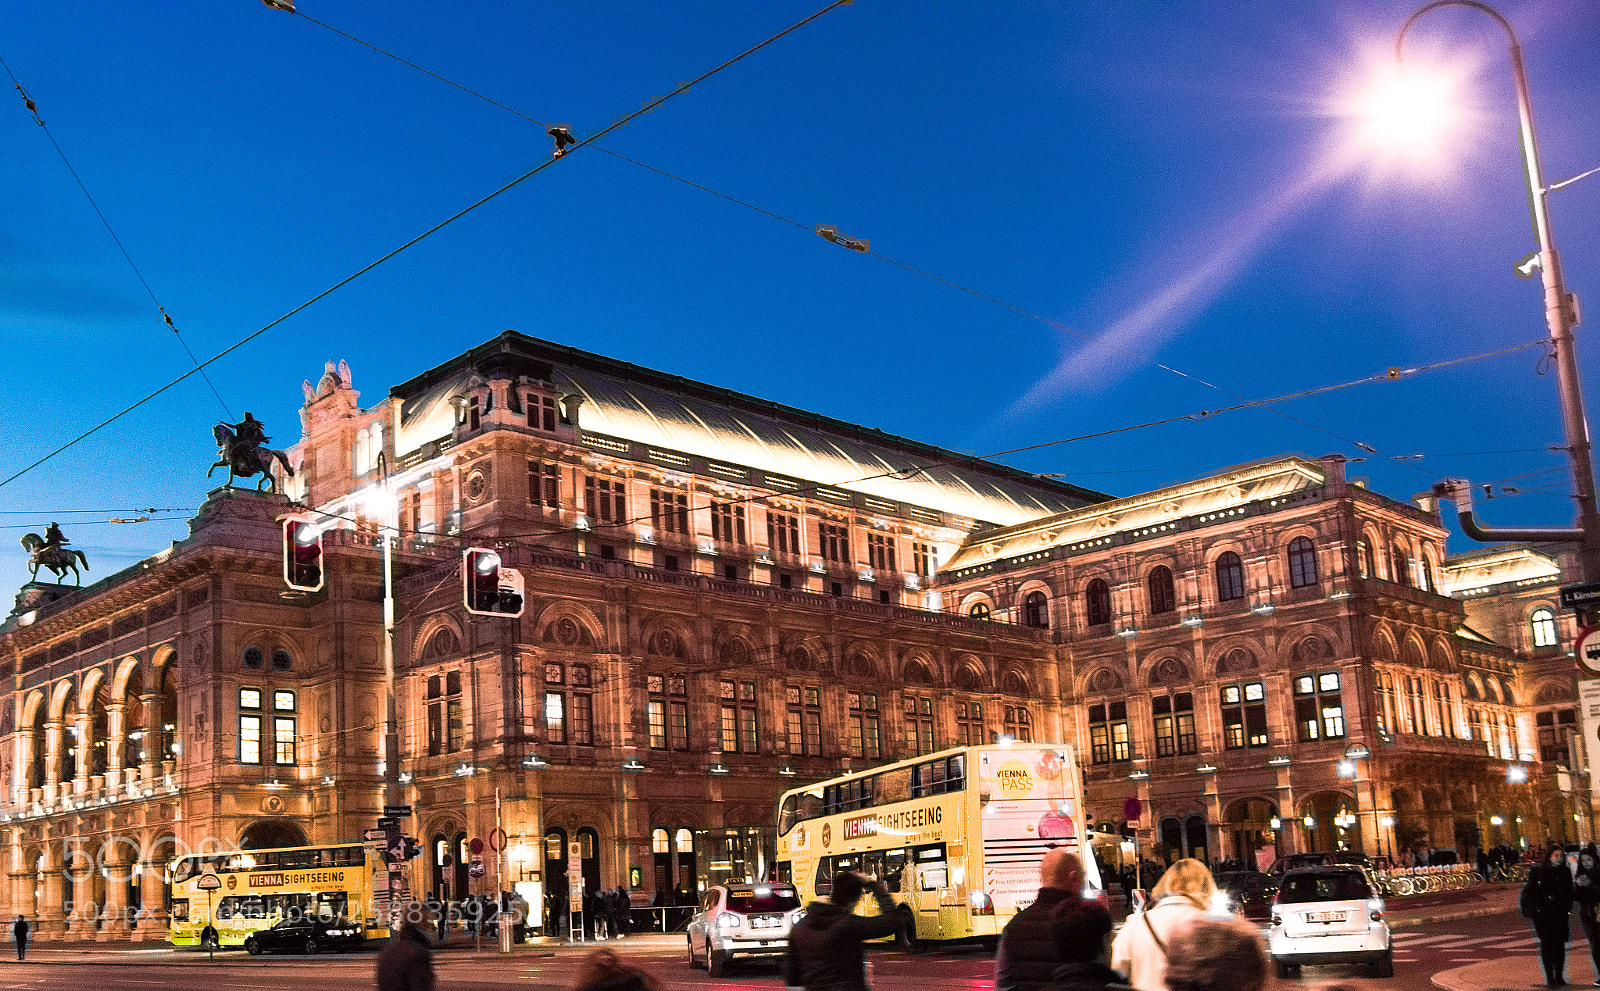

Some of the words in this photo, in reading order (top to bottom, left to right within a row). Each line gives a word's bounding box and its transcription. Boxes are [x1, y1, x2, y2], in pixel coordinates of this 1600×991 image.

[996, 770, 1028, 778] VIENNA
[1001, 777, 1033, 791] PASS
[845, 816, 877, 838] VIENNA
[878, 806, 942, 829] SIGHTSEEING
[250, 875, 283, 886] VIENNA
[285, 872, 345, 884] SIGHTSEEING
